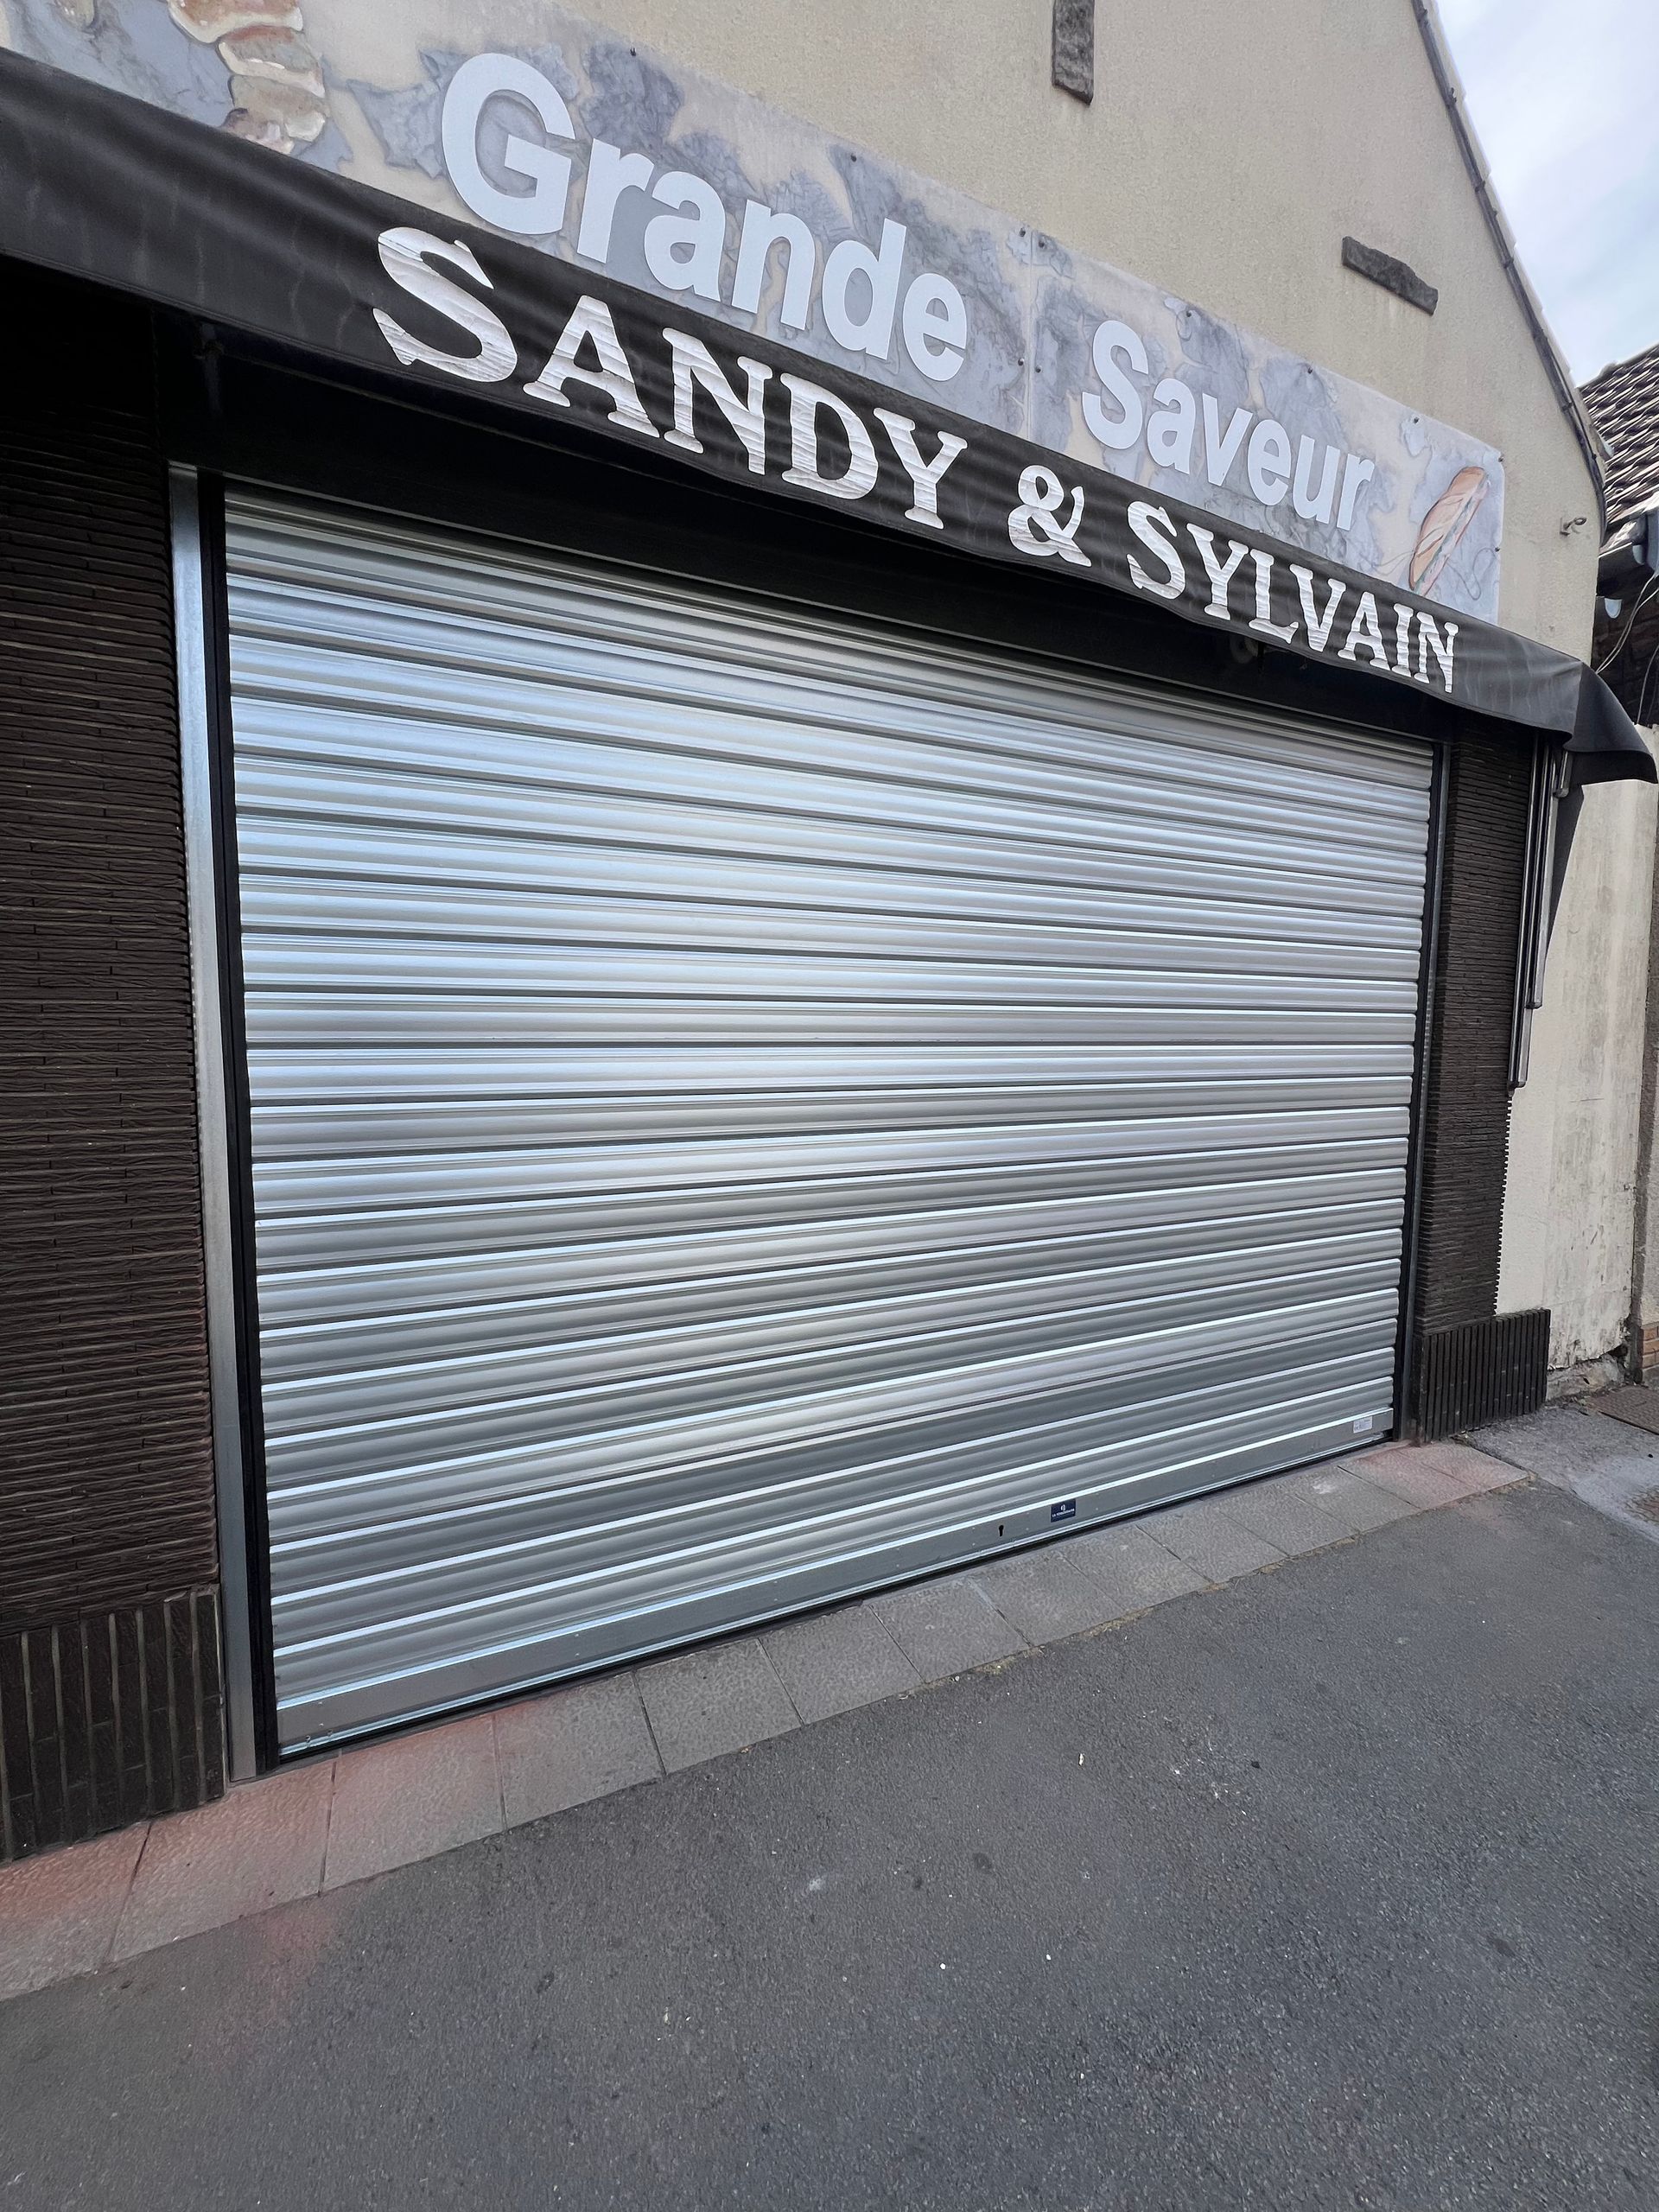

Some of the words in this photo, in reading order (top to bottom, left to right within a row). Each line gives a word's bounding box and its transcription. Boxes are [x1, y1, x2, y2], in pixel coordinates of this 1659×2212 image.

[372, 226, 967, 530] SANDY
[1007, 465, 1091, 567] &
[1126, 501, 1459, 693] SYLVAIN
[442, 53, 967, 381] Grande
[1082, 320, 1375, 530] Saveur
